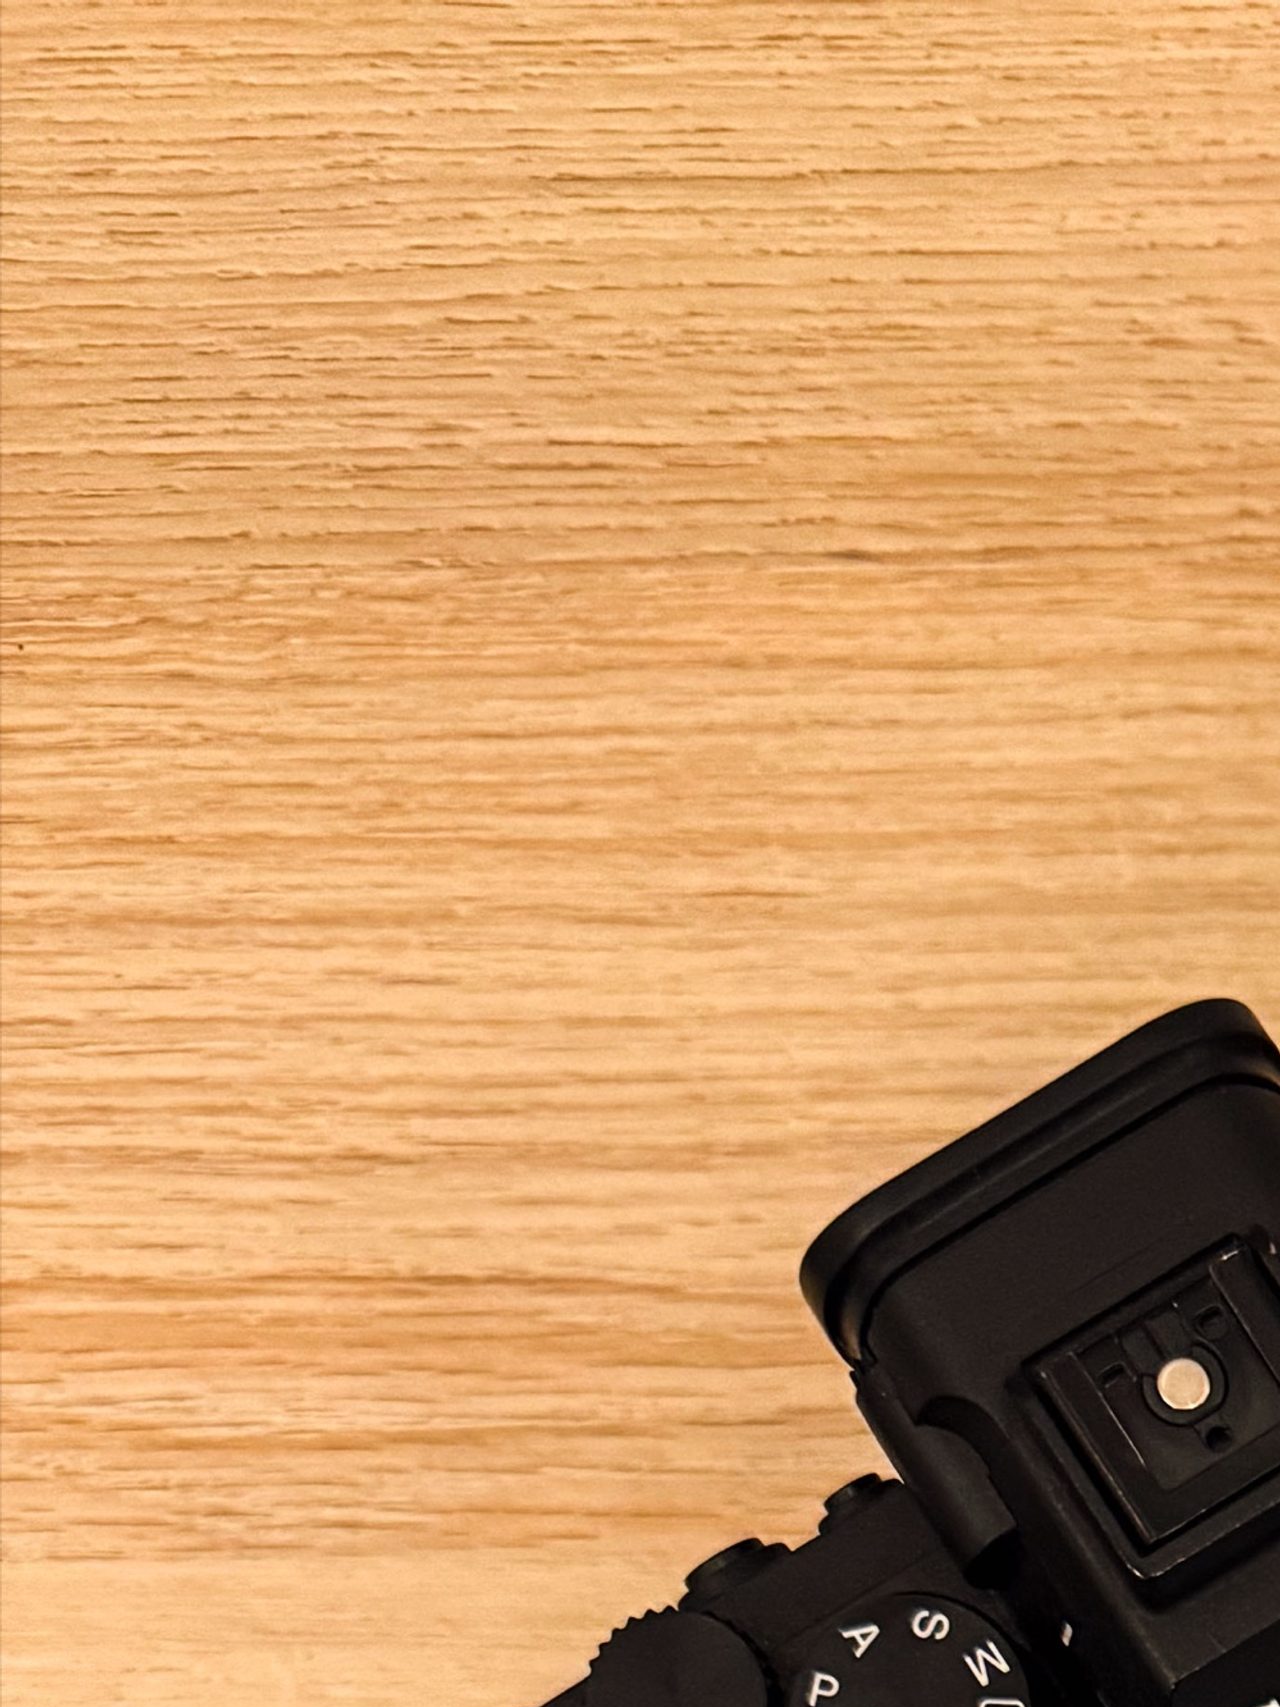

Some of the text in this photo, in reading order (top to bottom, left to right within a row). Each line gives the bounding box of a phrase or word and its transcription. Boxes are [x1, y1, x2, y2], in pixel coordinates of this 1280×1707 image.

[839, 1624, 880, 1659] A
[911, 1609, 950, 1640] S
[963, 1640, 1011, 1688] M
[807, 1671, 840, 1707] P
